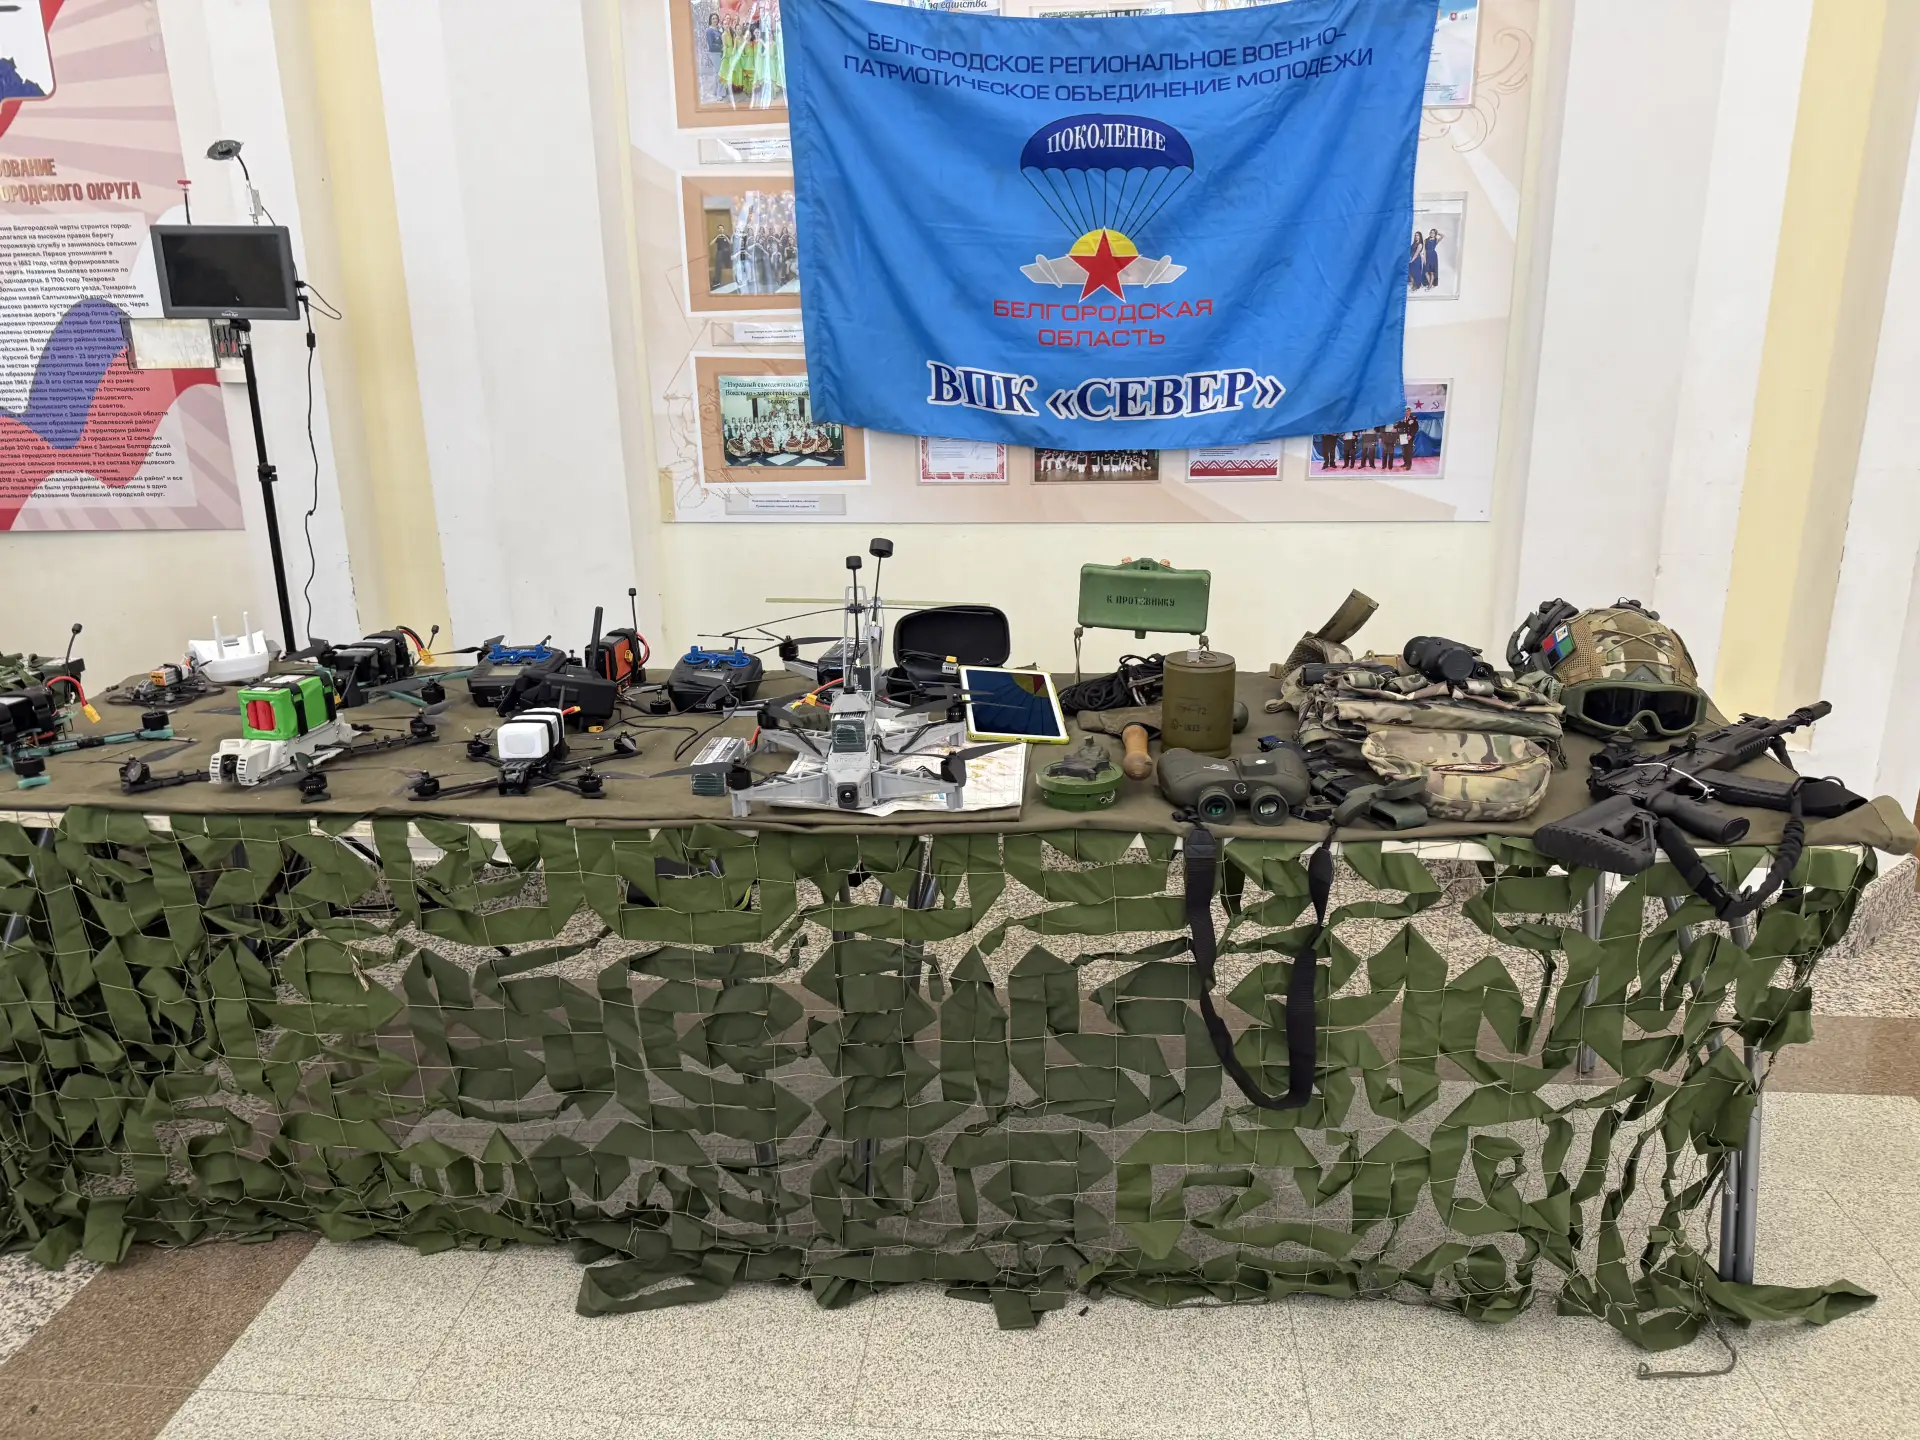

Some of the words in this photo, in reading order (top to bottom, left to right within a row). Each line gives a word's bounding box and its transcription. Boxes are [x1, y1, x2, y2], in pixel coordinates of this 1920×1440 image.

[867, 32, 1044, 74] БЕЛГОРОДСКОЕ
[1050, 49, 1236, 75] РЕГИОНАЛЬНОЕ
[1242, 26, 1347, 65] ВОЕННО-
[844, 55, 1049, 100] ПАТРИОТИЧЕСКОЕ
[1055, 73, 1230, 103] ОБЪЕДИНЕНИЕ
[1236, 48, 1373, 87] МОЛОДЕЖИ
[1047, 123, 1166, 154] ПОКОЛЕНИЕ
[0, 158, 57, 178] ОВАНИЕ
[0, 182, 84, 205] ОРОДСКОГО
[86, 181, 142, 201] ОКРУГА
[993, 299, 1213, 324] БЕЛГОРОДСКАЯ
[1037, 329, 1166, 348] ОБЛАСТЬ
[927, 358, 1040, 417] ВПК
[1046, 367, 1286, 421] «СЕВЕР»
[1106, 594, 1113, 604] К
